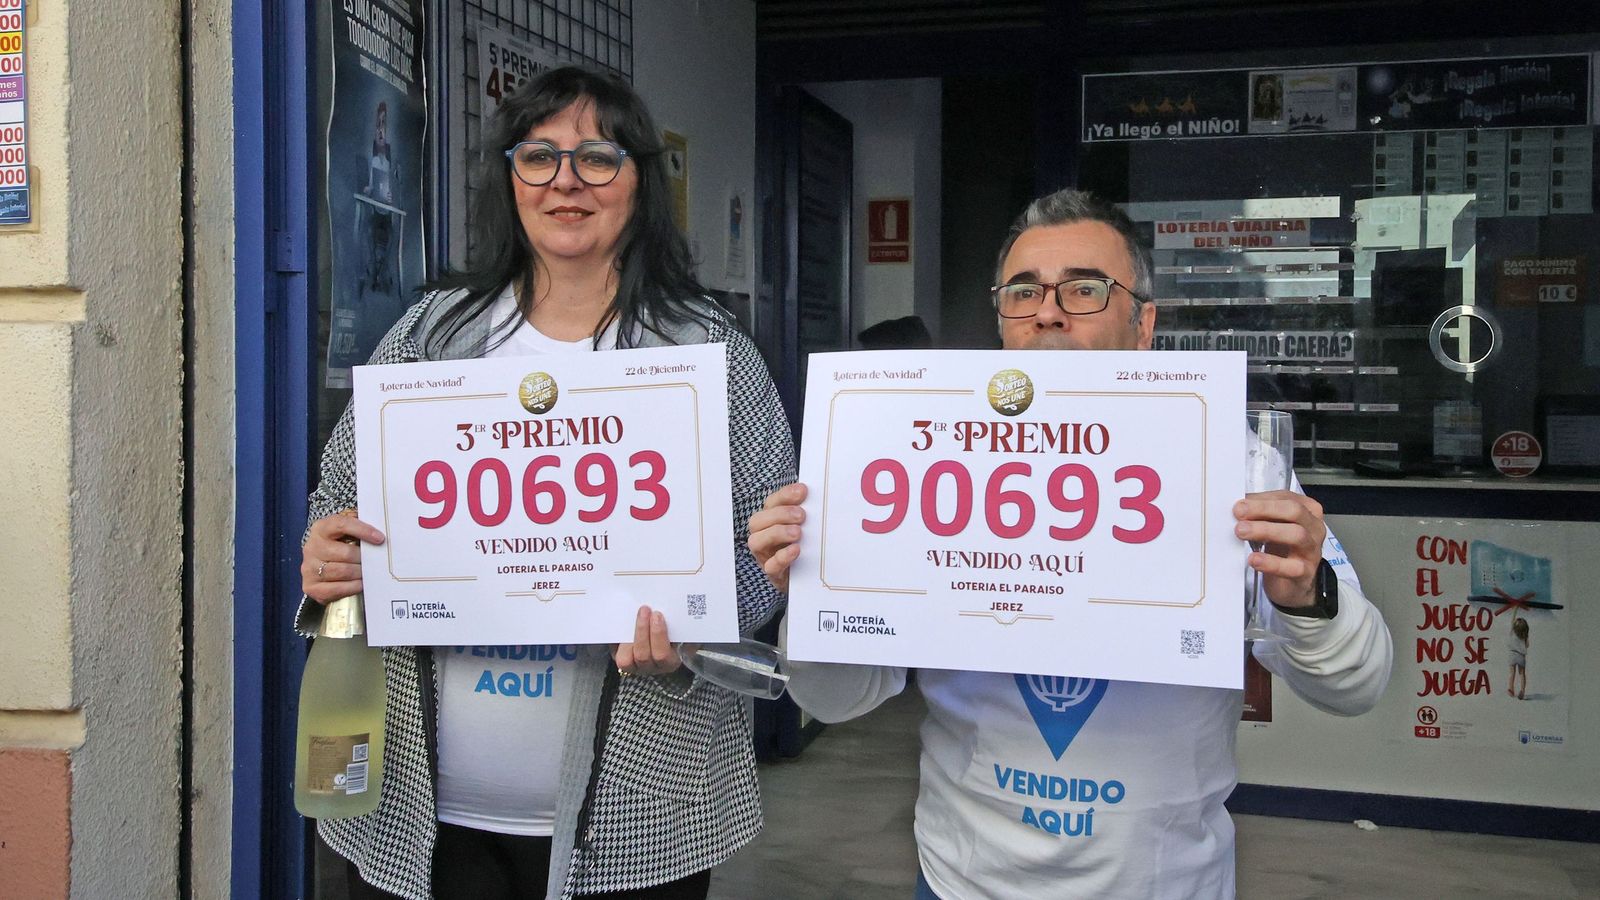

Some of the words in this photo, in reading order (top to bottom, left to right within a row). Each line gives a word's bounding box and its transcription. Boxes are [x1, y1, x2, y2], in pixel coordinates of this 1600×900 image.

[371, 4, 390, 38] COSA
[489, 42, 497, 65] 5
[487, 67, 527, 105] 45
[1088, 123, 1113, 141] ¡Ya
[1119, 122, 1161, 139] llegó
[1167, 121, 1182, 136] el
[1188, 117, 1240, 135] NIÑO!
[1158, 220, 1228, 233] LOTERÍA
[1233, 220, 1306, 232] VIAJERA
[1194, 236, 1224, 247] DEL
[1229, 234, 1273, 247] NIÑO
[1504, 259, 1534, 267] PAGO
[1504, 267, 1527, 276] CON
[1540, 286, 1560, 300] 10
[1216, 335, 1280, 357] CIUDAD
[1285, 332, 1351, 358] CAERÁ?
[625, 367, 635, 376] 22
[637, 366, 648, 375] de
[649, 364, 697, 376] Diciembre
[869, 370, 881, 379] de
[883, 368, 928, 379] Navidad
[1116, 371, 1129, 380] 22
[1131, 371, 1144, 381] de
[1146, 371, 1207, 382] Diciembre
[414, 380, 425, 389] de
[426, 376, 466, 388] Navidad
[492, 415, 624, 450] PREMIO
[954, 421, 1110, 455] PREMIO
[1502, 436, 1529, 451] +18
[413, 450, 671, 530] 90693
[860, 458, 1165, 545] 90693
[475, 536, 557, 556] VENDIDO
[563, 531, 609, 556] AQUÍ
[1416, 535, 1468, 565] CON
[497, 564, 537, 575] LOTERIA
[539, 563, 550, 573] EL
[552, 562, 594, 573] PARAISO
[926, 550, 1022, 571] VENDIDO
[1029, 551, 1085, 577] AQUÍ
[532, 581, 560, 590] JEREZ
[951, 581, 997, 592] LOTERIA
[999, 582, 1012, 593] EL
[1014, 584, 1065, 596] PARAISO
[1416, 568, 1444, 597] EL
[411, 602, 447, 611] LOTERÍA
[412, 610, 456, 620] NACIONAL
[990, 601, 1024, 612] JEREZ
[842, 614, 886, 625] LOTERÍA
[1416, 602, 1494, 632] JUEGO
[842, 625, 897, 636] NACIONAL
[1416, 637, 1454, 664] NO
[1463, 635, 1490, 665] SE
[474, 666, 554, 698] AQUÍ
[1416, 669, 1491, 698] JUEGA
[1418, 728, 1436, 737] +18
[994, 763, 1126, 804] VENDIDO
[1021, 807, 1095, 837] AQUÍ
